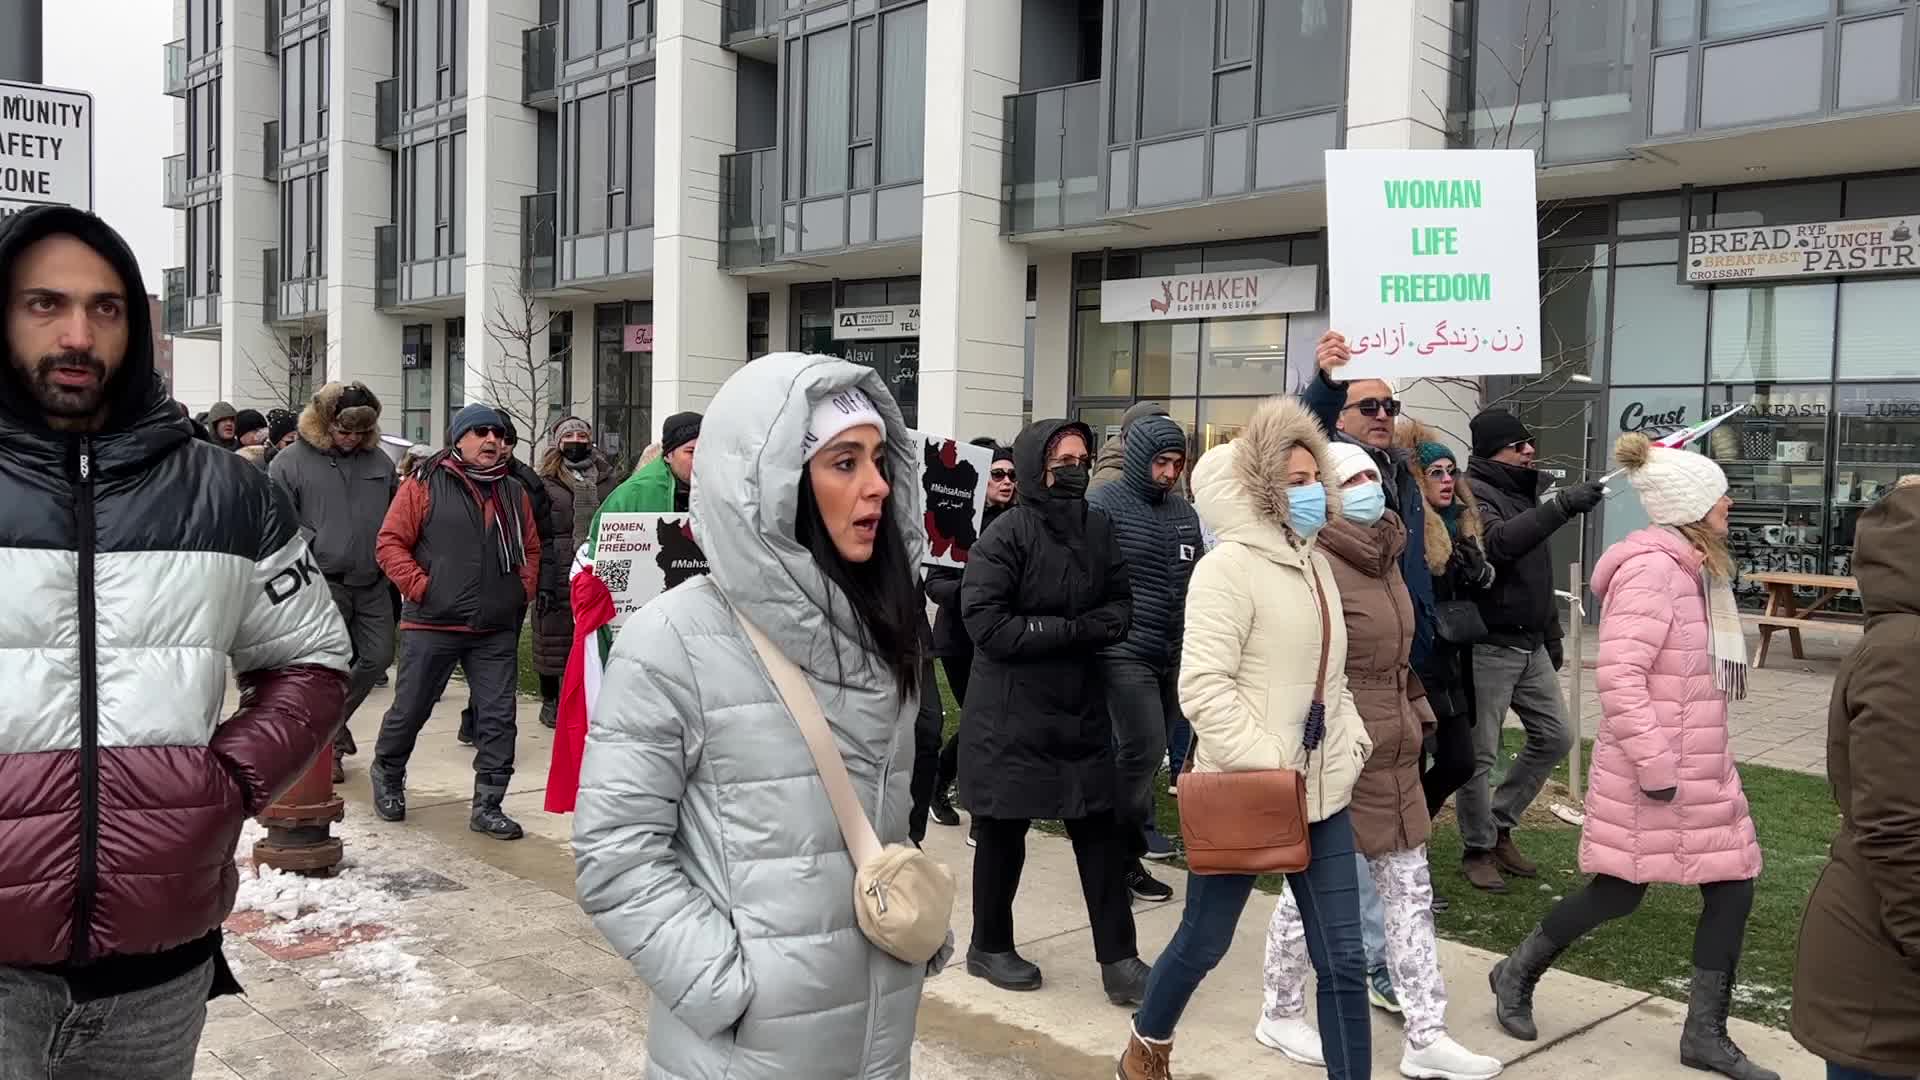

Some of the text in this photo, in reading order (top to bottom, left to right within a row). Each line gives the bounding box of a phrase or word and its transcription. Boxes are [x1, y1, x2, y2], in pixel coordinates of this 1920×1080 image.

[0, 167, 50, 194] ONE
[1384, 179, 1482, 208] WOMAN
[1796, 224, 1827, 236] RYE
[1412, 227, 1458, 256] LIFE
[1813, 232, 1883, 249] LUNCH
[1704, 244, 1920, 271] BREAKFAST PASTR
[1690, 268, 1755, 279] CROISSANT
[1177, 275, 1258, 303] CHAKEN
[1380, 273, 1491, 303] FREEDOM
[1177, 301, 1257, 312] FASHION DESIGN
[845, 349, 874, 362] Alavi
[1620, 402, 1687, 432] Crust
[931, 483, 972, 498] #MahsaAmini
[601, 522, 646, 532] WOMEN,
[598, 543, 651, 552] FREEDOM
